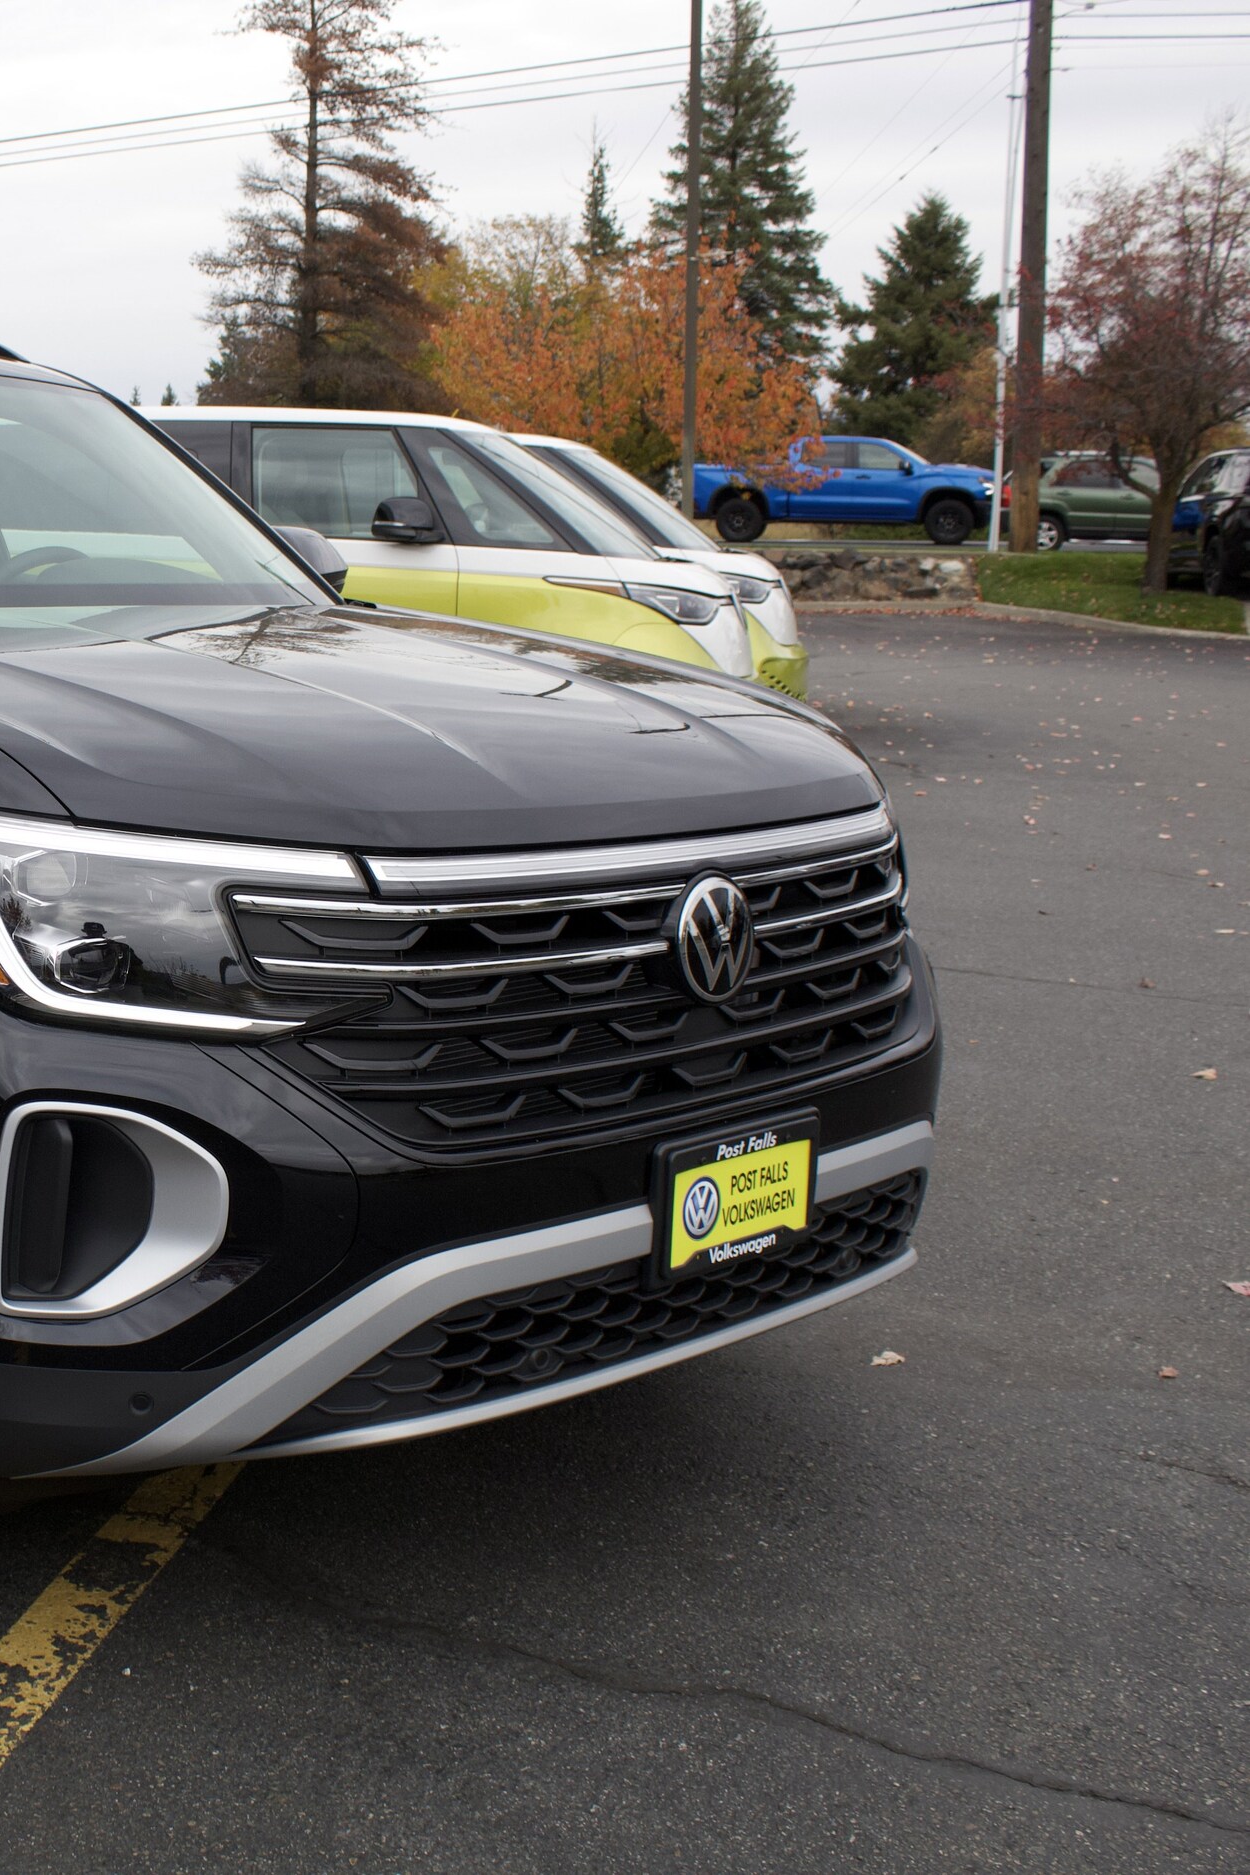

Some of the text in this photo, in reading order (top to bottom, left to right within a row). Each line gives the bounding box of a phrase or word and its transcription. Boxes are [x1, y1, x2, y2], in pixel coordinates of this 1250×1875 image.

[717, 1131, 777, 1161] Post Falls
[730, 1162, 789, 1195] POST FALLS
[722, 1189, 795, 1227] VOLKSWAGEN
[709, 1234, 776, 1263] Volkswagen
